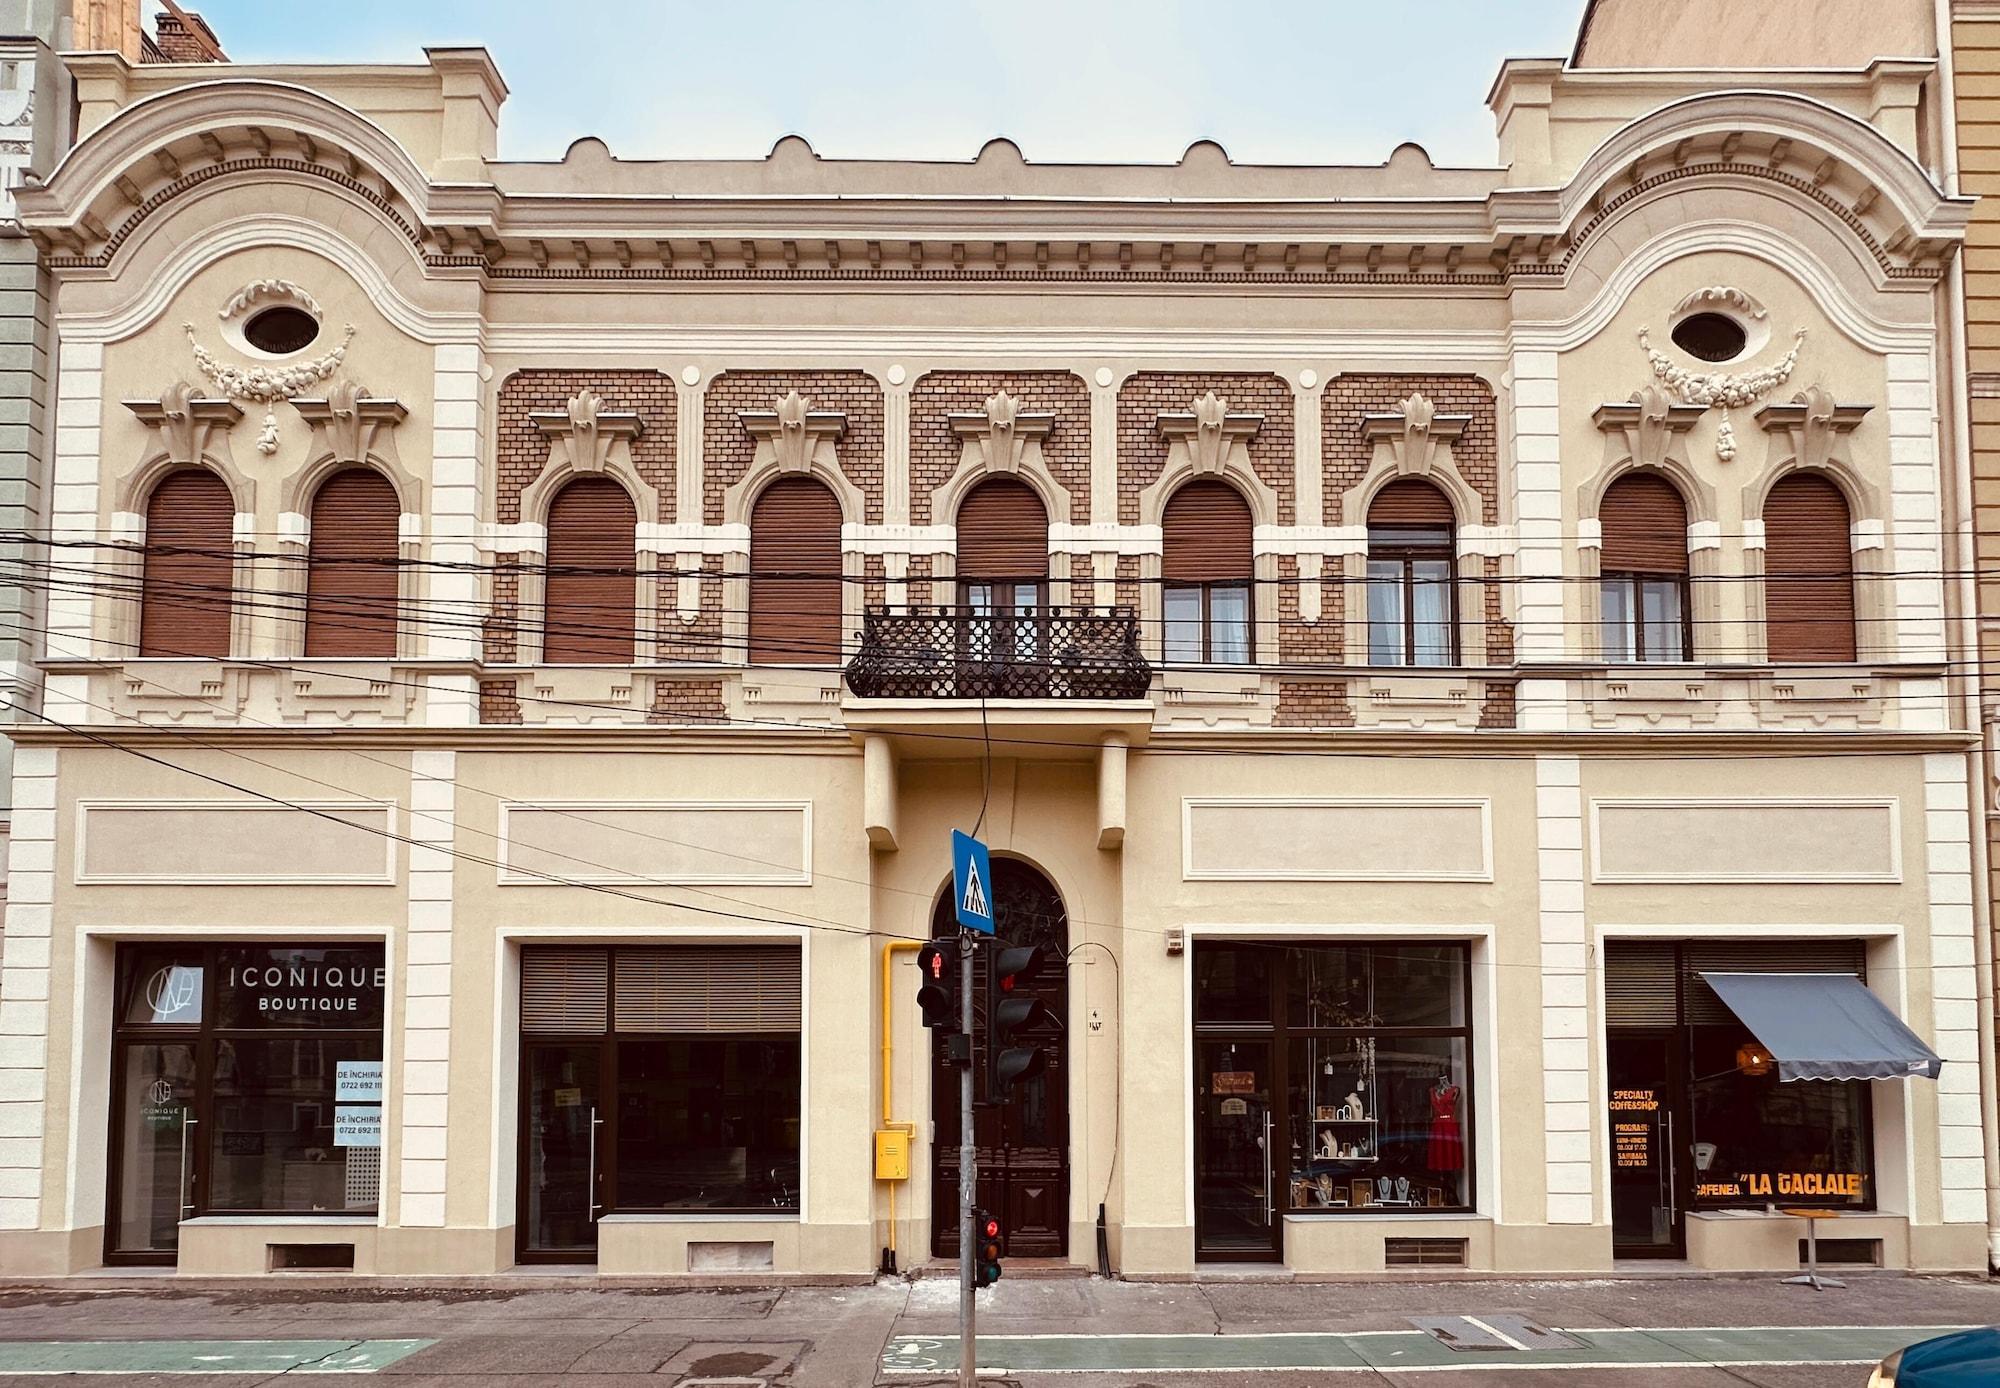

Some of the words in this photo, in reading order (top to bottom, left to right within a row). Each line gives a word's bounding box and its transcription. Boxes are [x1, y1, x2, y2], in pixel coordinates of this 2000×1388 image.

[230, 967, 385, 987] ICONIQUE
[258, 998, 358, 1011] BOUTIQUE
[337, 1071, 348, 1079] DE
[1613, 1090, 1654, 1100] SPECIALTY
[348, 1115, 381, 1124] ÎNCHIRIA
